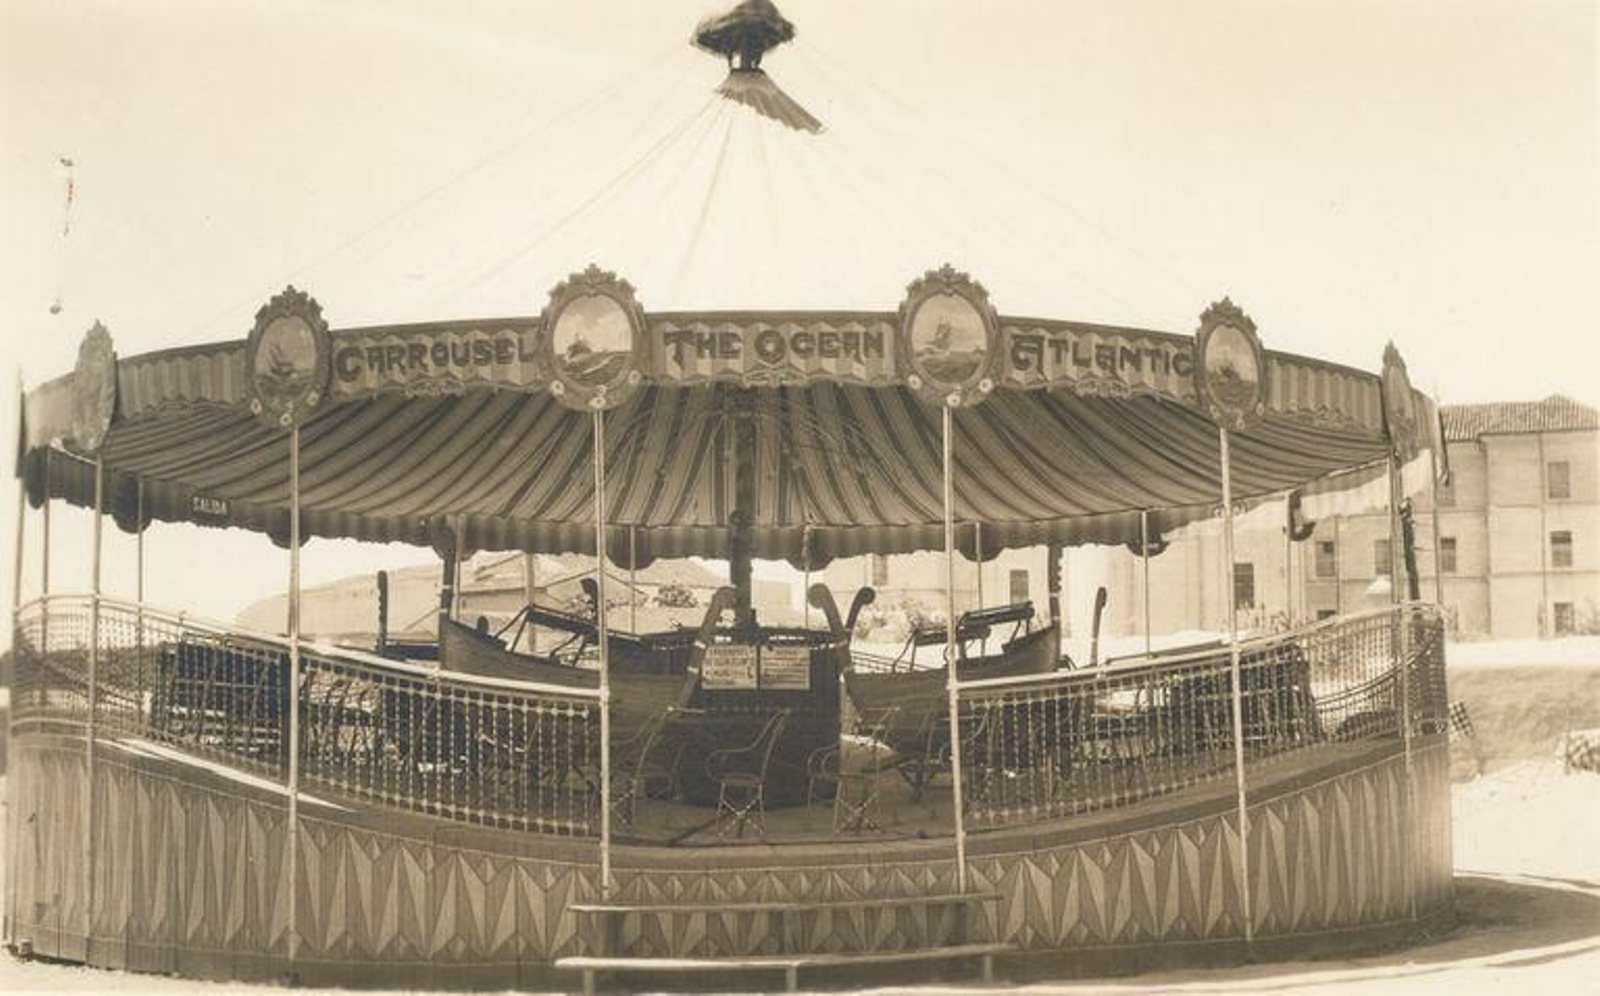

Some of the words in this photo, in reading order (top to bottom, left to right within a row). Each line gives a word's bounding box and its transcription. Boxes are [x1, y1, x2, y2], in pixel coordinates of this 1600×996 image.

[335, 337, 534, 383] CARROUSEL
[663, 329, 743, 370] THE
[754, 329, 885, 364] OCEAN
[1011, 333, 1194, 379] ATLANTIC
[192, 497, 228, 515] SALIDA
